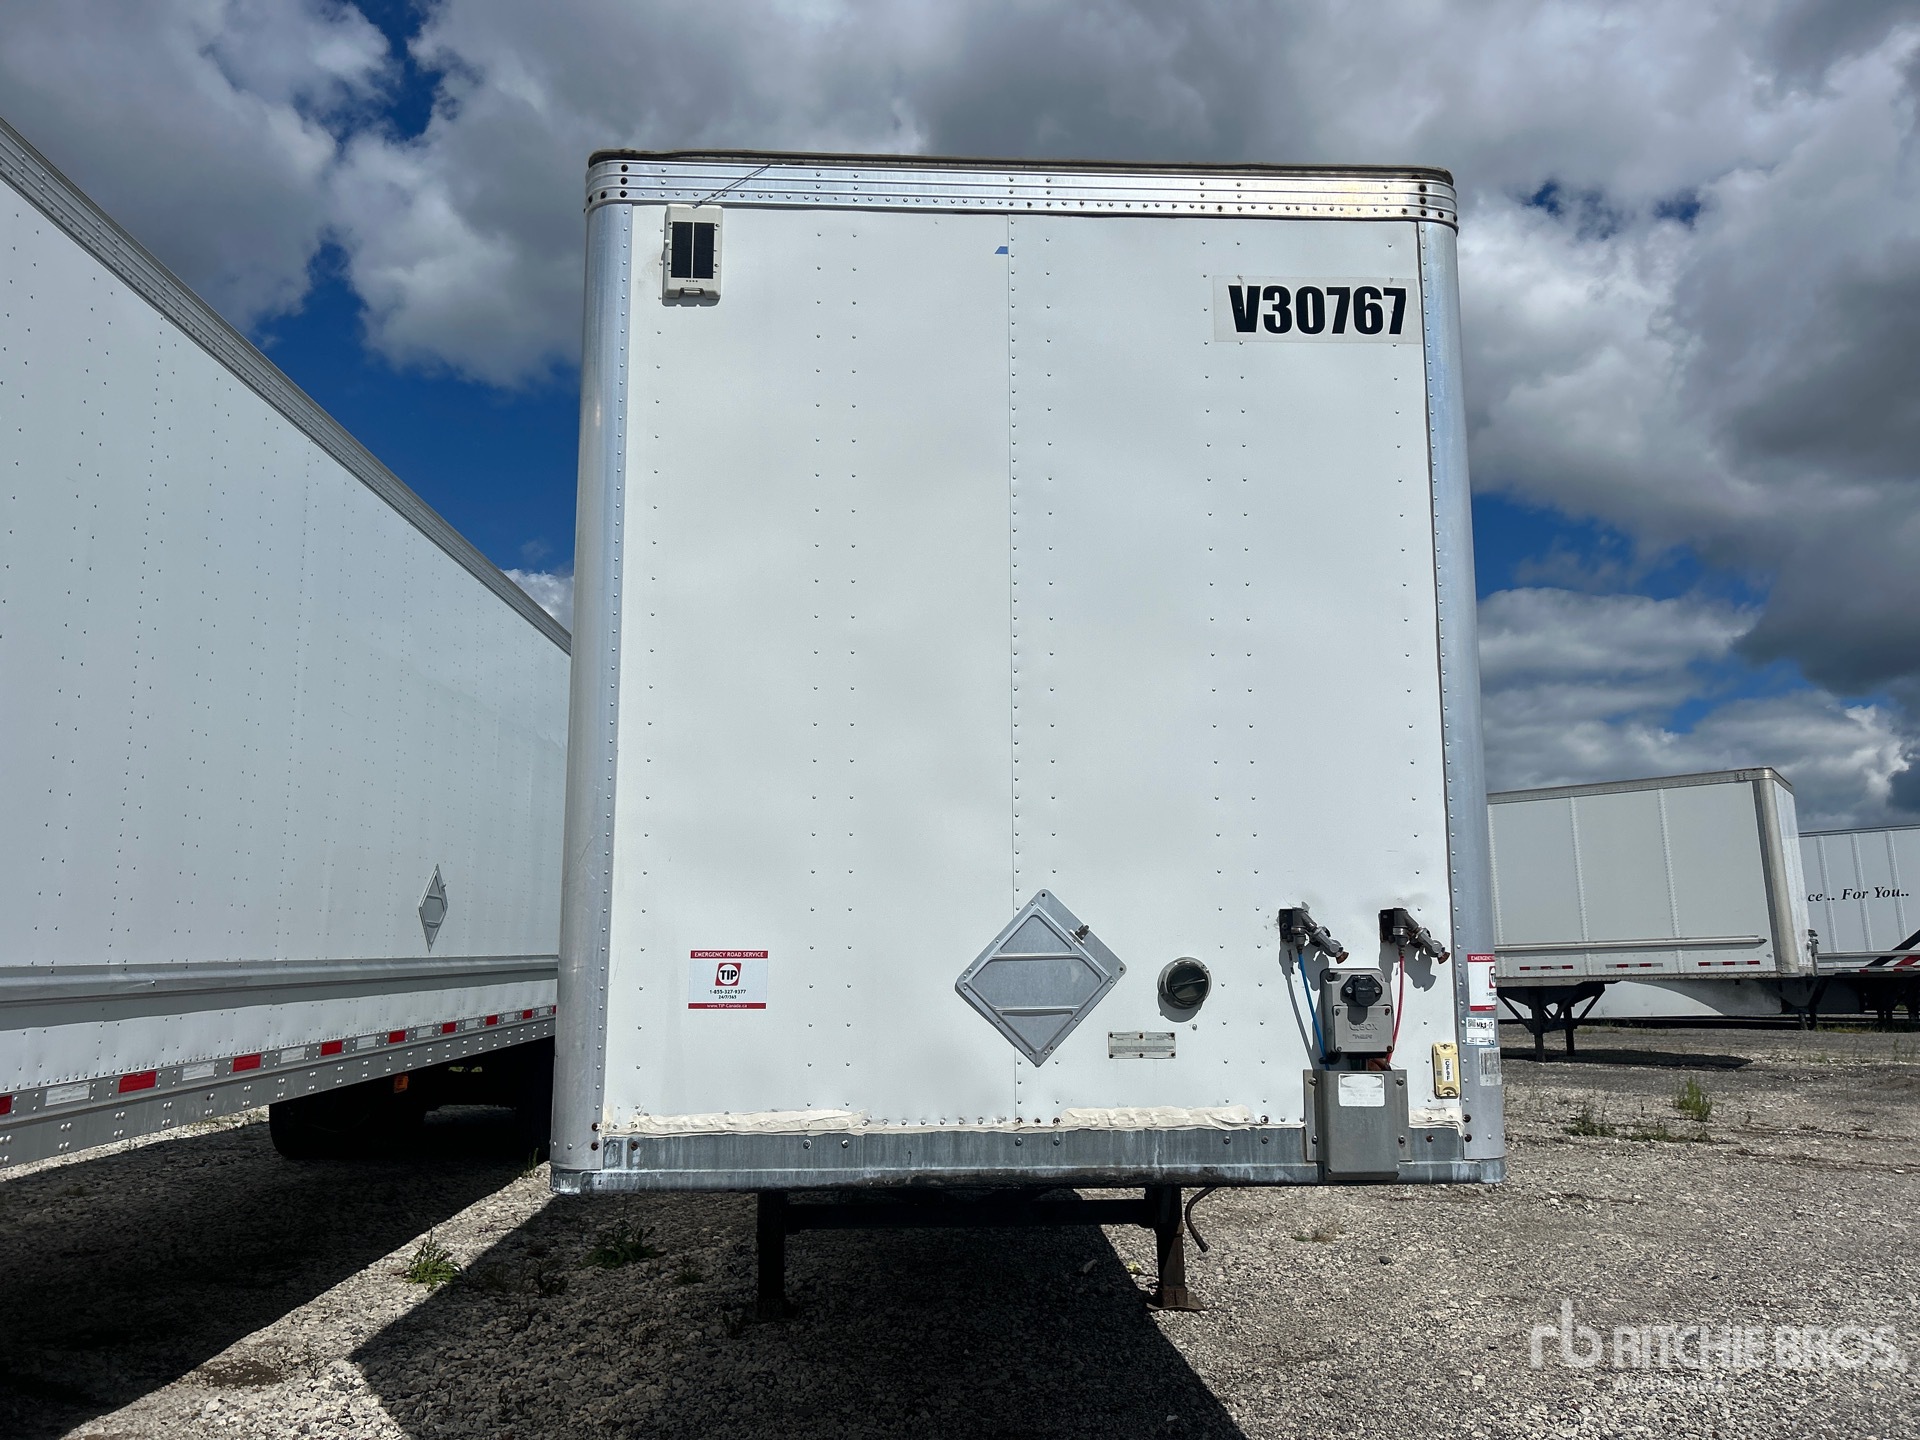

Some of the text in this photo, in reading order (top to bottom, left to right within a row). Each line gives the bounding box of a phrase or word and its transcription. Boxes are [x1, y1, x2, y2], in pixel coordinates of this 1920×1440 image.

[1228, 285, 1407, 335] V30767
[1807, 893, 1823, 902] ce
[1841, 888, 1869, 901] For
[720, 970, 737, 980] TIP
